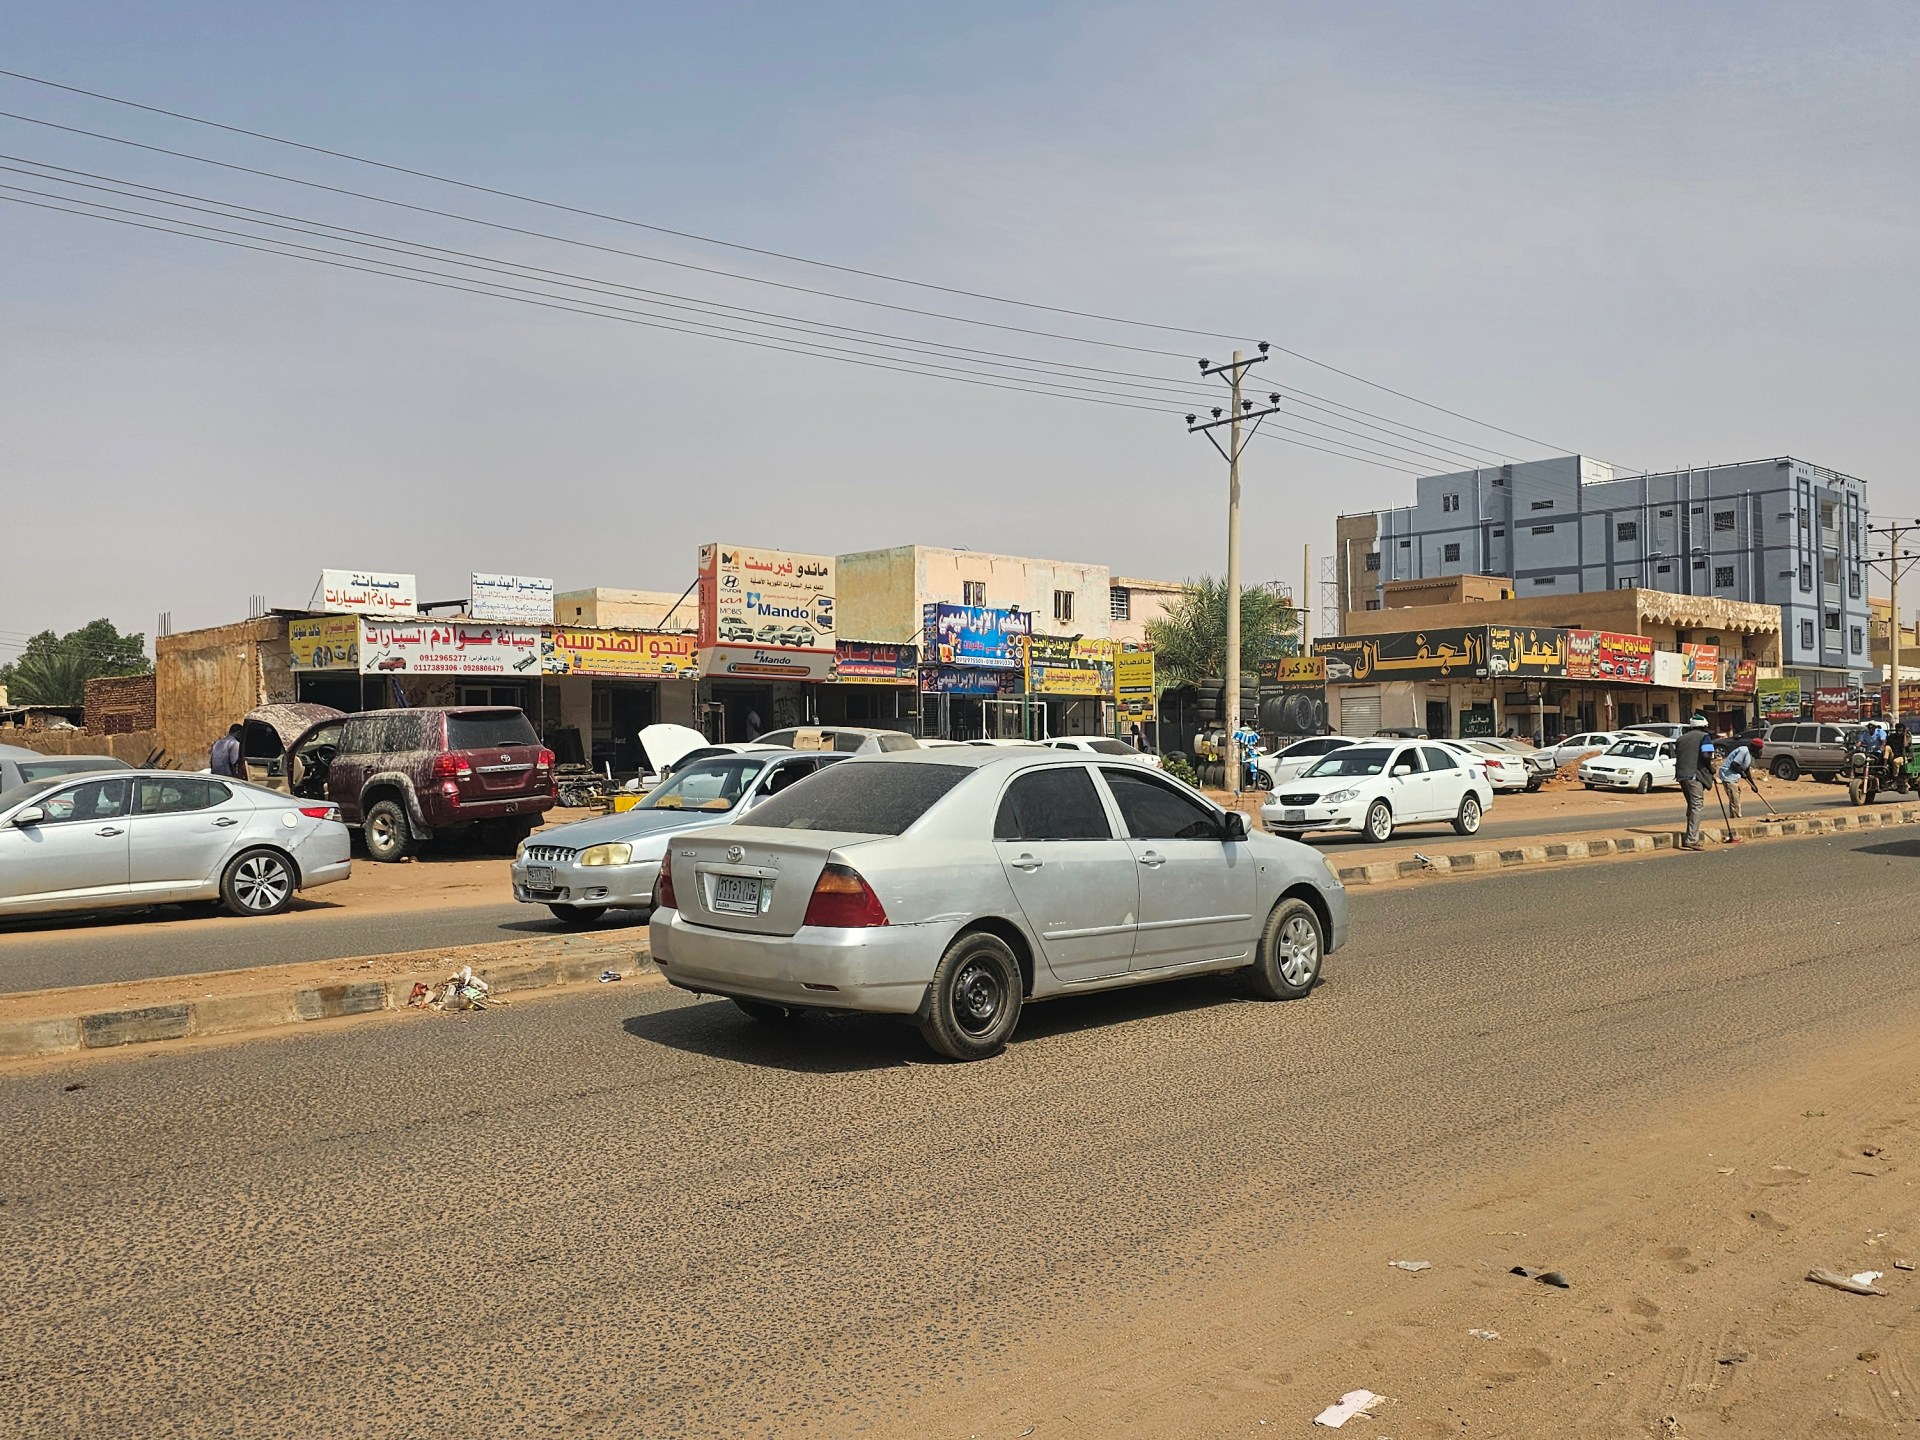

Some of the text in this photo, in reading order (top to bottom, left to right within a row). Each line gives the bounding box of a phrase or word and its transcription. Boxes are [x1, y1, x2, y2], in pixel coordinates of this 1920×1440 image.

[744, 557, 793, 576] فيرست
[796, 562, 828, 578] ماندو
[351, 574, 400, 592] صيانة
[472, 574, 553, 595] بنجو الهندسية
[325, 589, 413, 609] عوادم السيارات
[758, 603, 809, 619] Mando
[998, 613, 1029, 636] المطعم
[365, 626, 427, 649] السيارات
[431, 623, 494, 651] عوادم
[496, 628, 536, 652] صيانة
[555, 629, 689, 660] بنجو الهندسية
[419, 654, 467, 662] 0912965277
[759, 656, 791, 665] Mando
[834, 643, 898, 665] خالد صالح
[1353, 632, 1484, 680] الجفال
[1508, 629, 1567, 673] الجفال
[1280, 662, 1300, 678] كبرو
[1303, 659, 1324, 676] أولاد
[1816, 690, 1849, 704] البهجة
